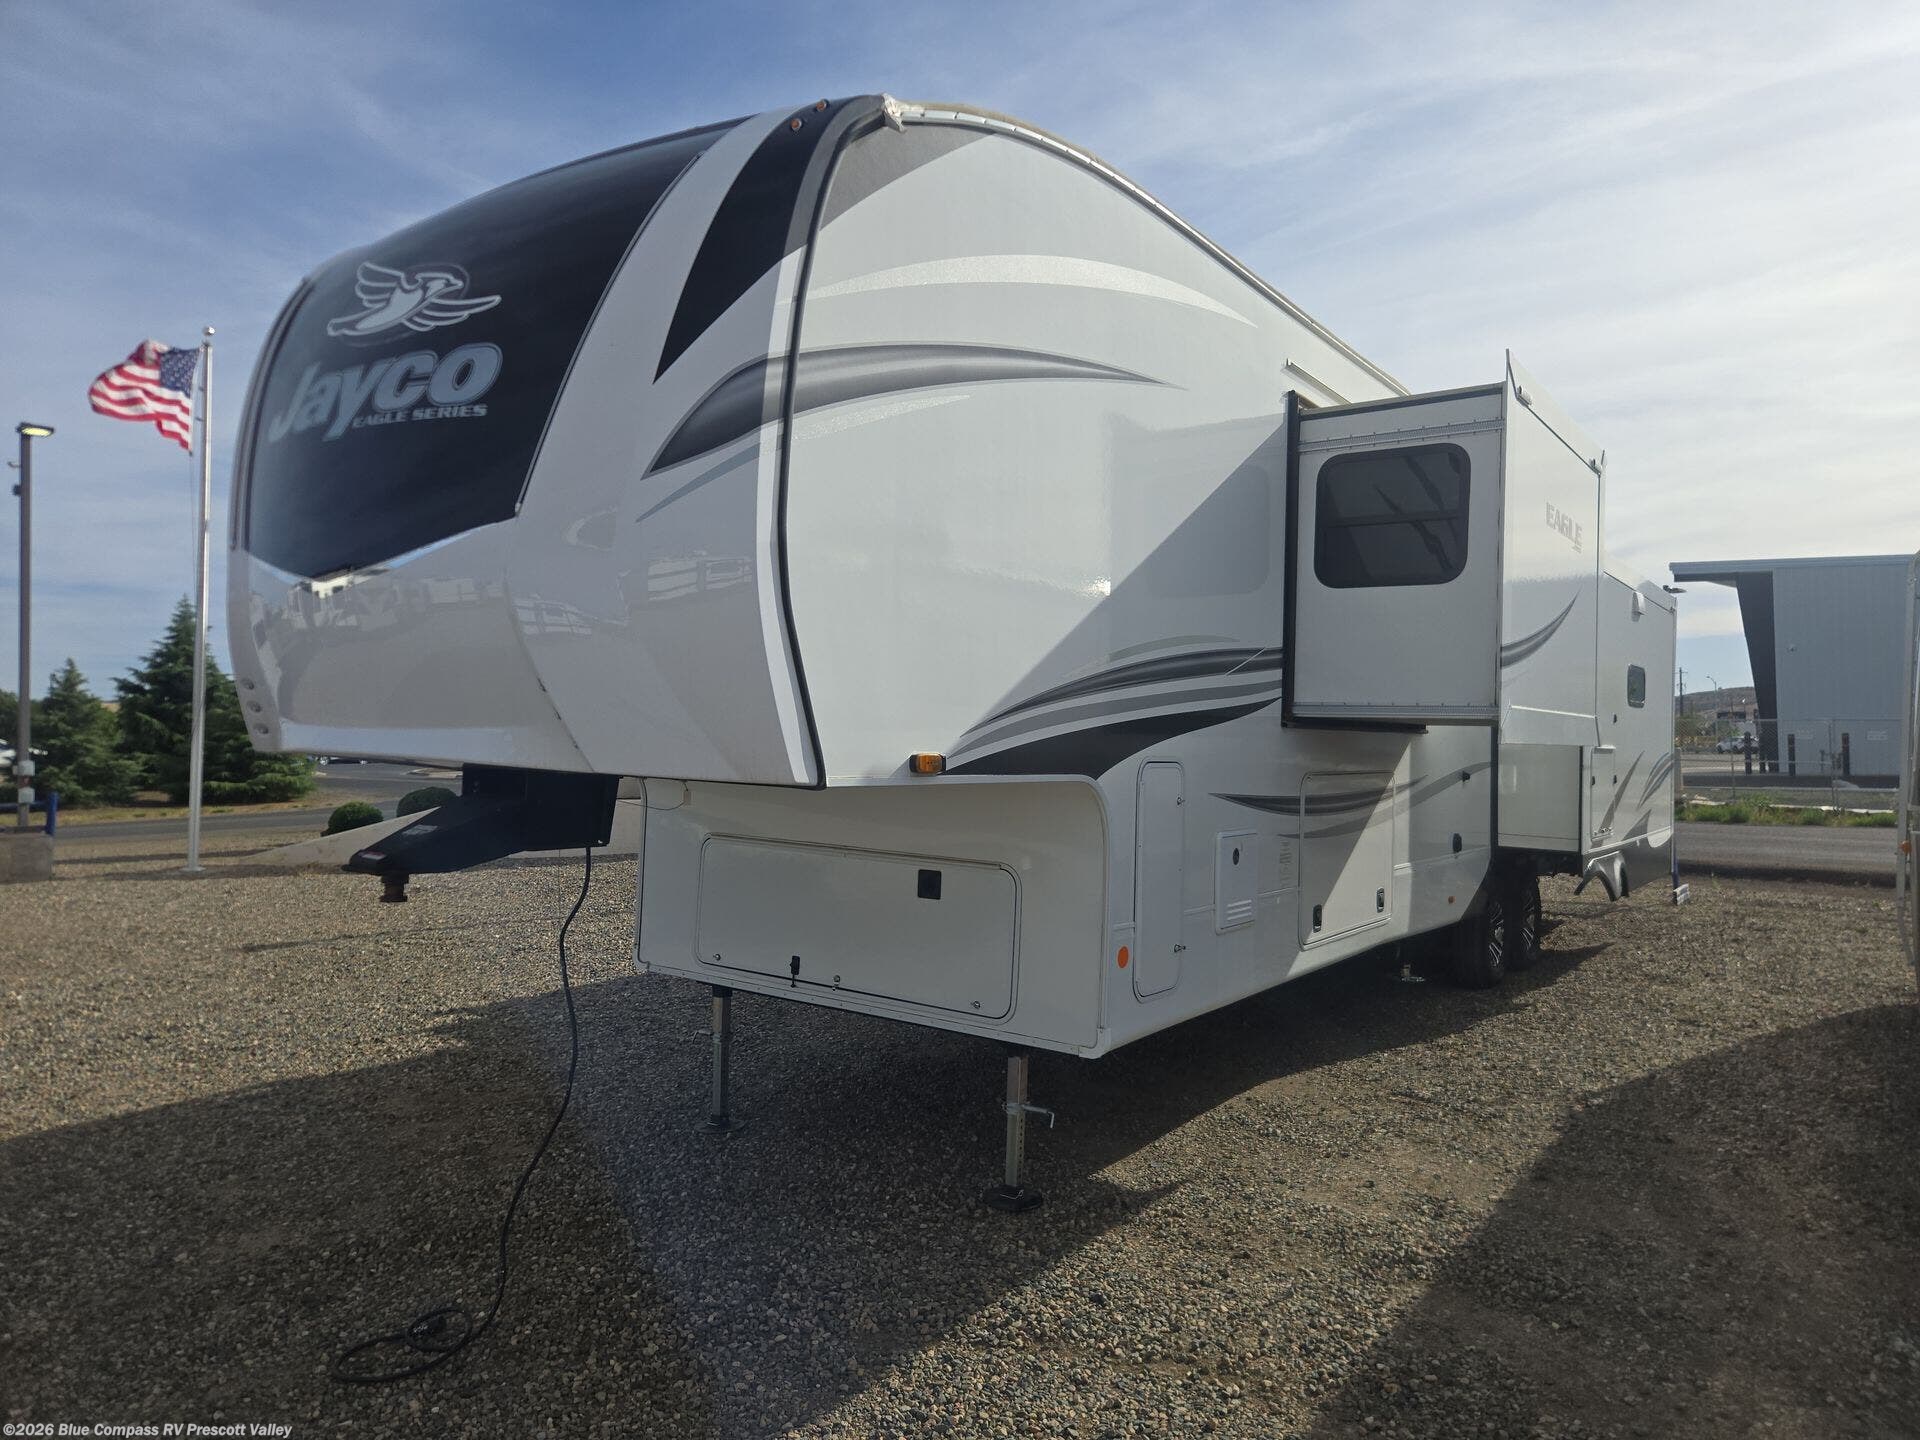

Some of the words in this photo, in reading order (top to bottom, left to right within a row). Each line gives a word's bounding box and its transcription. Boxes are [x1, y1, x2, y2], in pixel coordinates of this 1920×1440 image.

[352, 411, 409, 428] EAGLE
[412, 403, 488, 421] SERIES
[1545, 501, 1583, 547] EAGLE
